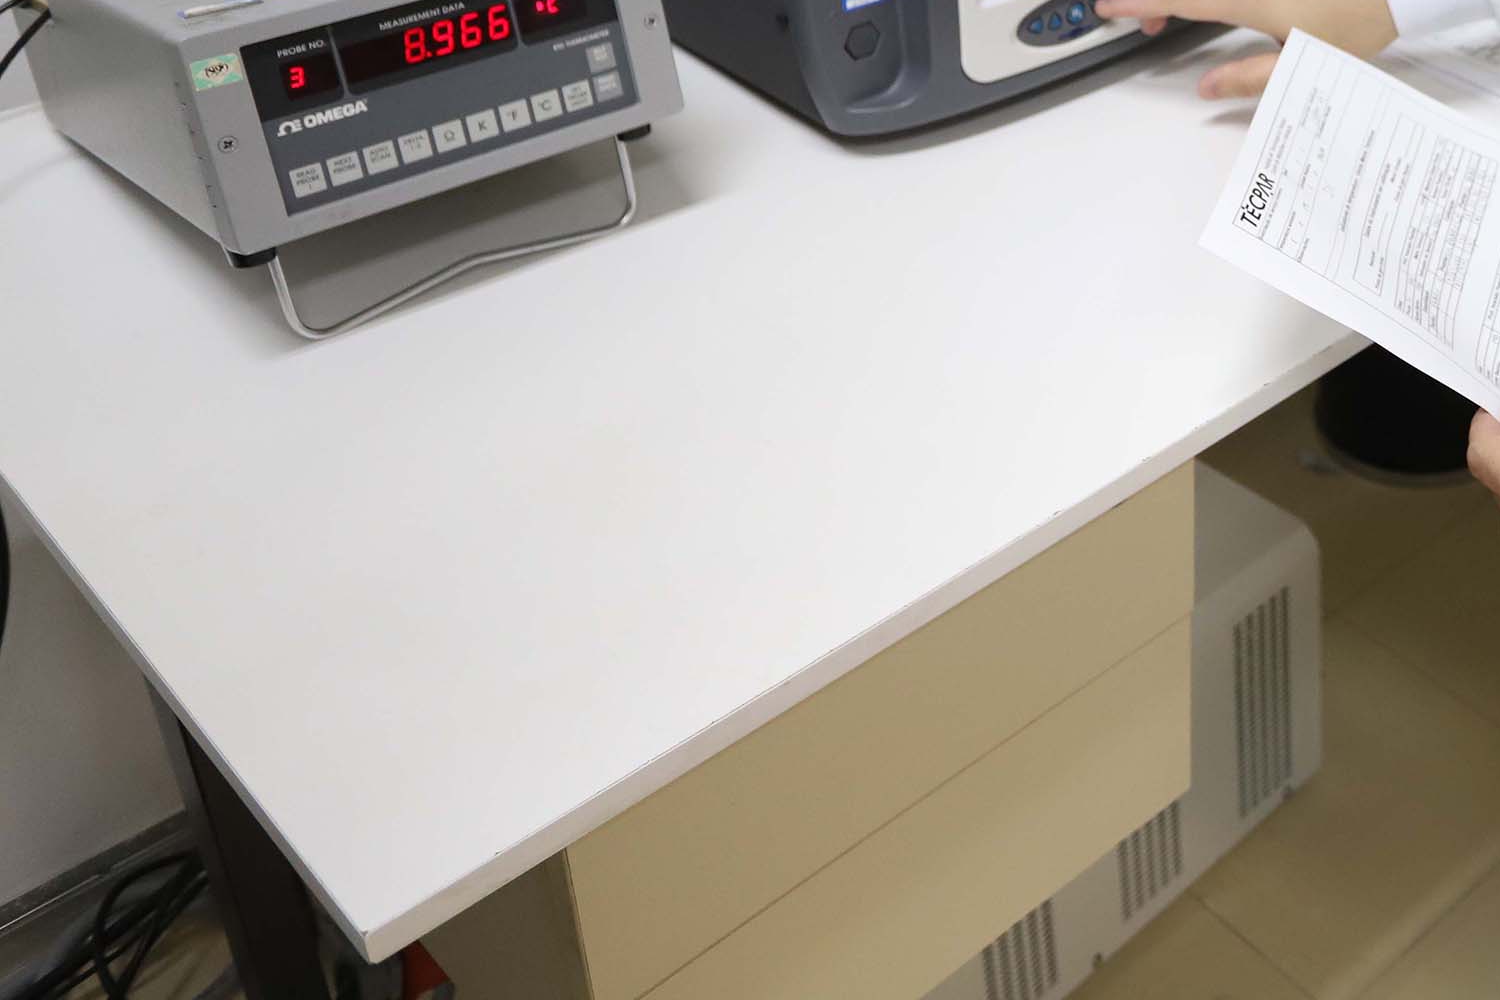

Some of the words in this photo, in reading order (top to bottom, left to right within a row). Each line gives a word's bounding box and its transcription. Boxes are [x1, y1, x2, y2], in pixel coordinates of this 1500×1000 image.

[379, 7, 440, 31] MEASUREMENT
[442, 1, 465, 16] DATA
[276, 45, 307, 58] PROBE
[308, 38, 326, 51] NO.
[403, 3, 510, 65] 8.966
[289, 66, 305, 89] 3
[303, 100, 368, 129] OMEGA
[478, 121, 487, 132] K
[1240, 172, 1275, 227] TECPAR
